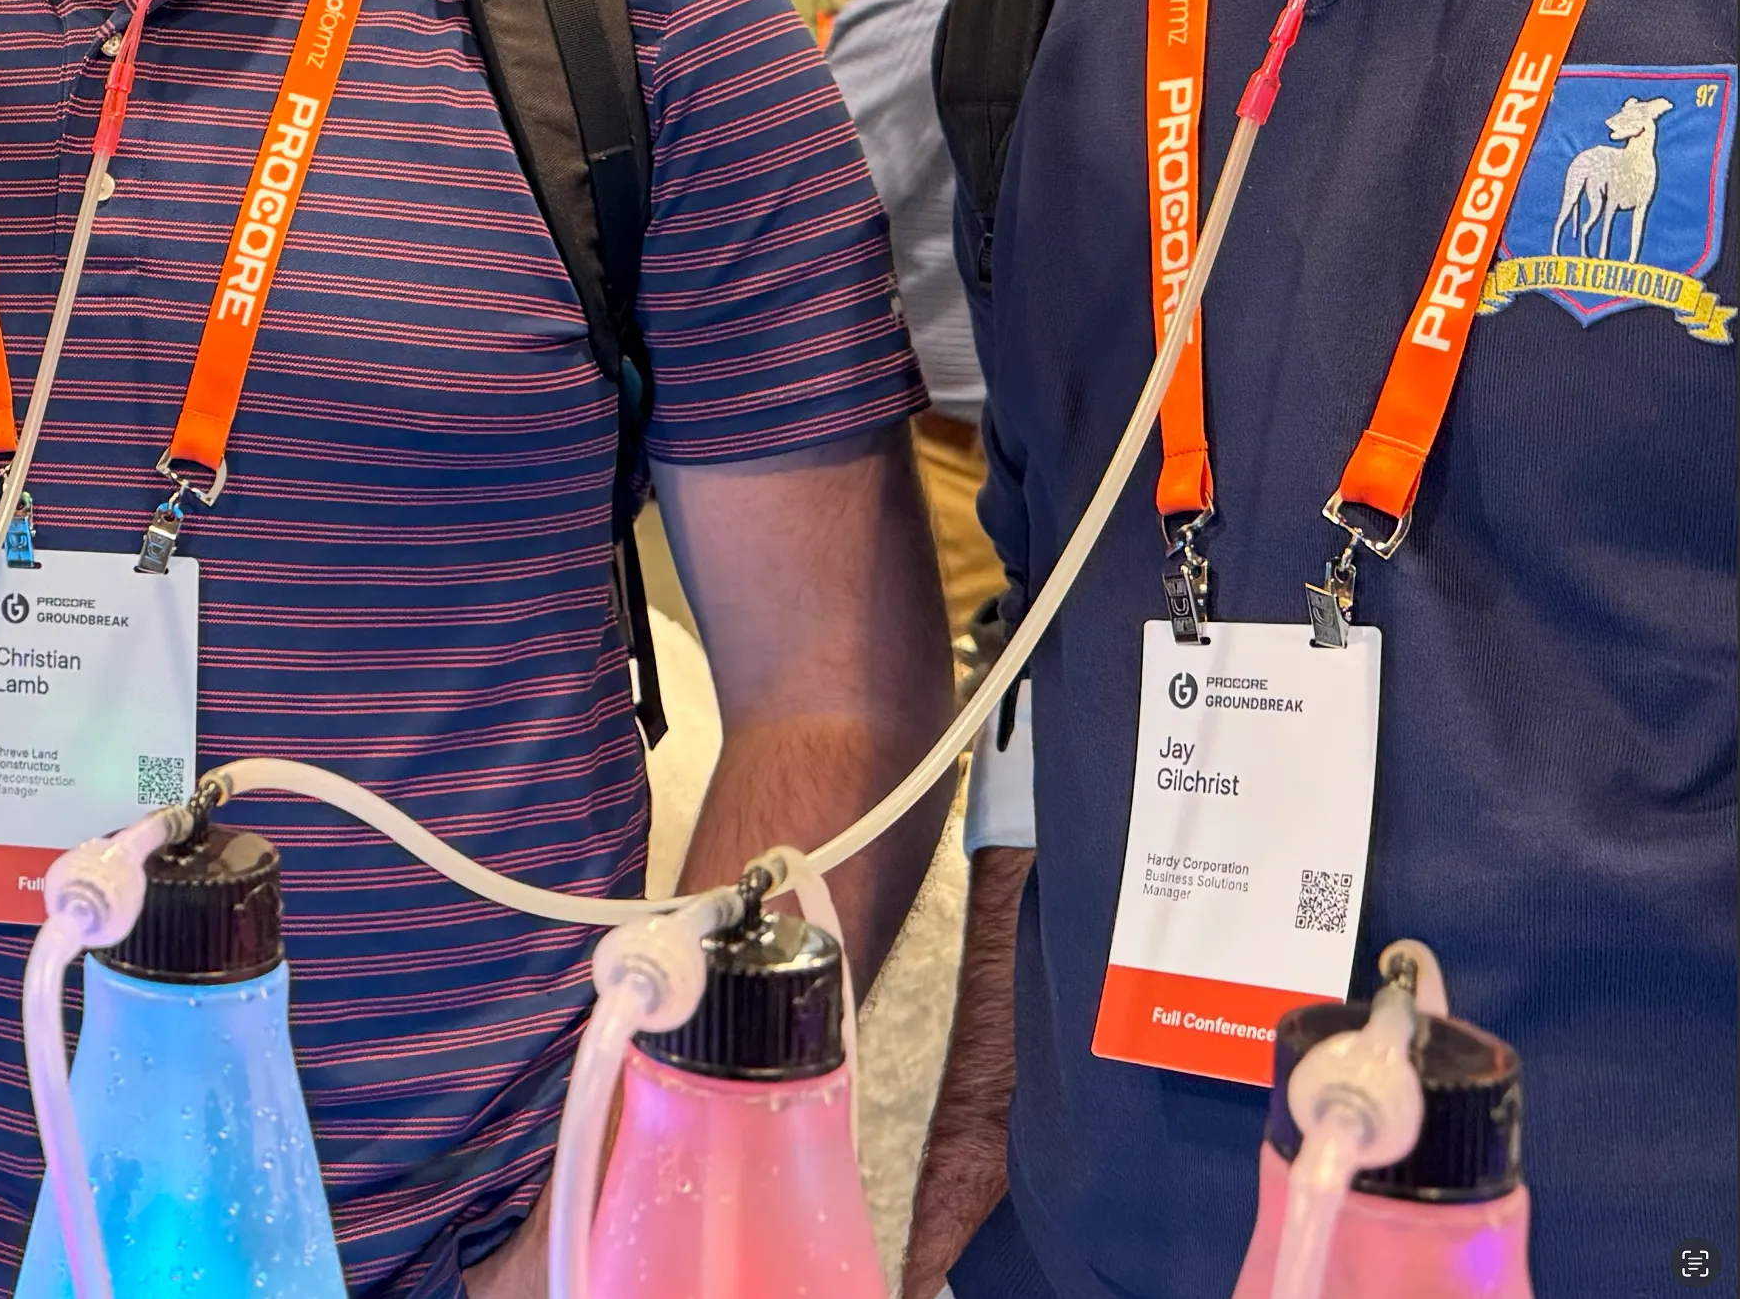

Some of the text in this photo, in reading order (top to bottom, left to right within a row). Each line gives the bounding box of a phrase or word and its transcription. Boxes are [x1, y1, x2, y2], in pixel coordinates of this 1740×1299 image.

[1695, 84, 1720, 108] 97
[217, 92, 321, 328] PROCORE
[1411, 52, 1553, 353] PROCORE
[1564, 261, 1684, 304] RICHMOND
[36, 596, 95, 609] PROCORE
[36, 612, 130, 627] GROUNDBREAK
[1205, 675, 1268, 691] PROCORE
[1205, 694, 1303, 713] GROUNDBREAK
[31, 747, 58, 760] Land
[1159, 736, 1196, 766] Jay
[1156, 767, 1240, 797] Gilchrist
[1146, 852, 1249, 876] Hardy Corporation
[17, 876, 44, 891] Full
[1142, 882, 1192, 902] Manager
[1144, 868, 1249, 892] Business Solutions
[1151, 1006, 1276, 1043] Full Conference
